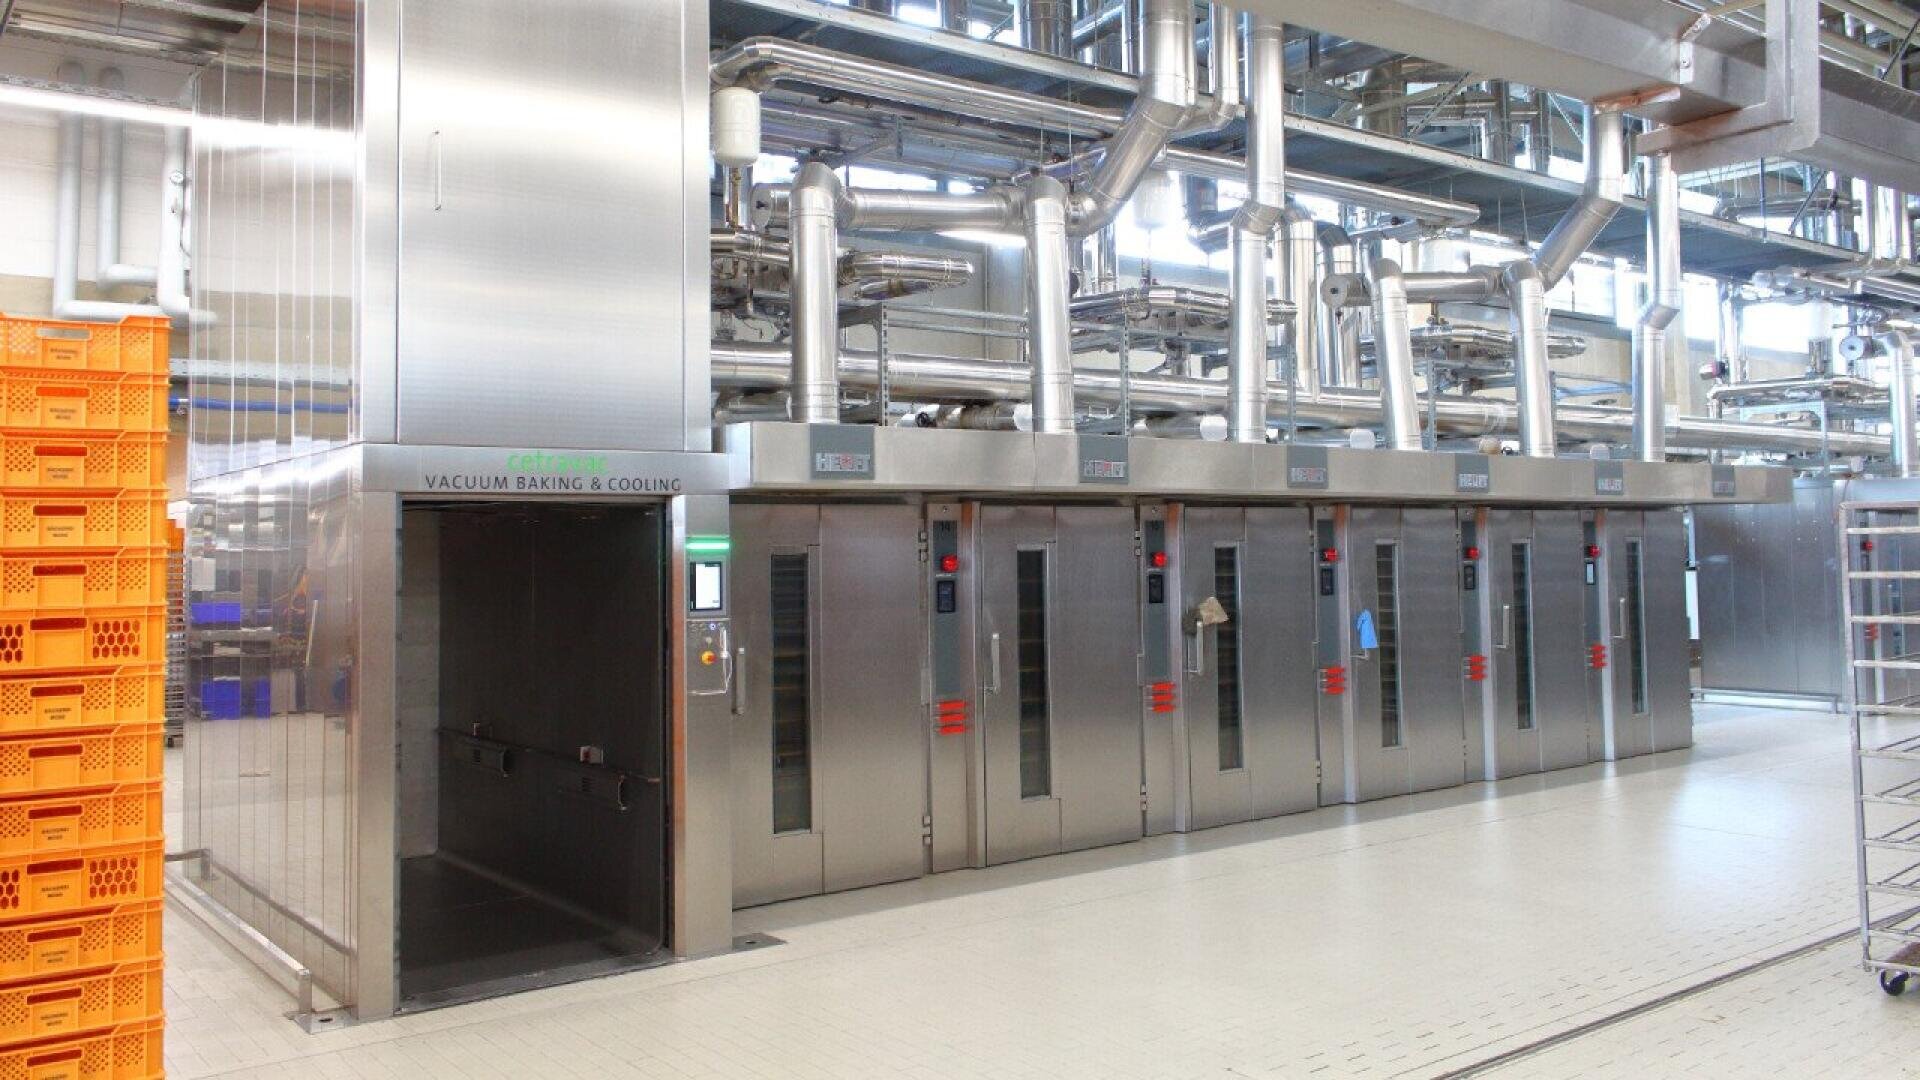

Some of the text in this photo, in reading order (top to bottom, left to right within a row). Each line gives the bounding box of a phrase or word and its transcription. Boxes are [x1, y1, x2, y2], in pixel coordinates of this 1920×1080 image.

[507, 451, 608, 473] cetravac
[425, 474, 682, 492] VACUUM BAKING & COOLING
